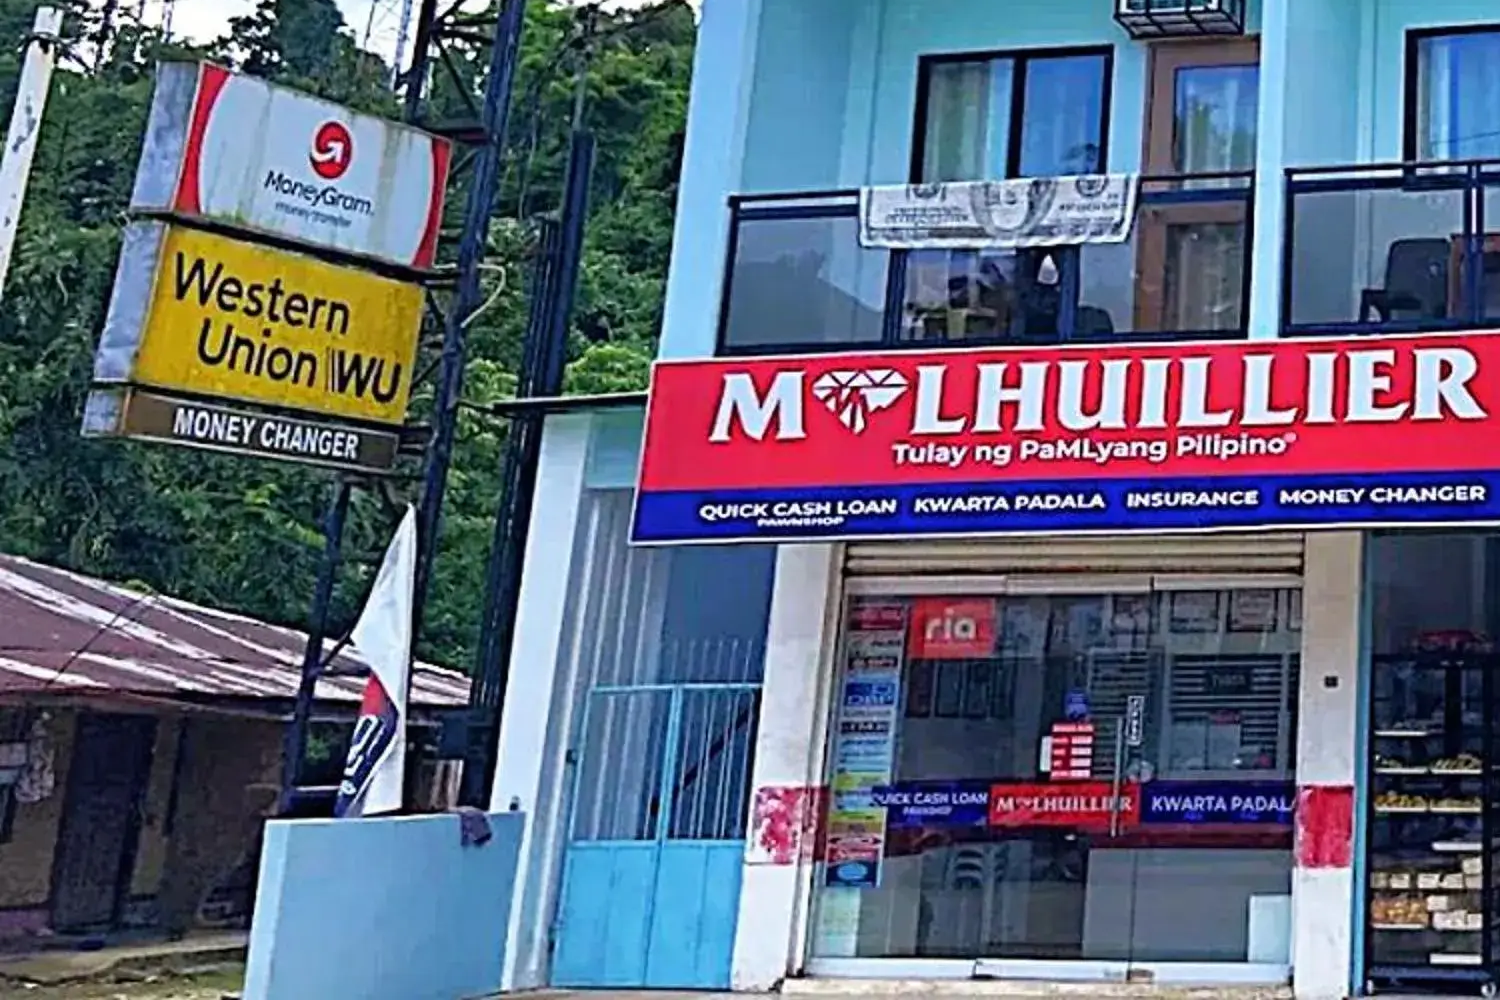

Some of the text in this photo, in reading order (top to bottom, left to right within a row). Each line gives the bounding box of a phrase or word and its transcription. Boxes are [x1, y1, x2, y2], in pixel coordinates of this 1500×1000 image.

[264, 170, 372, 215] MoneyGram
[175, 252, 349, 335] Western
[199, 318, 400, 403] Union WU
[173, 407, 359, 460] MONEY CHANGER
[893, 434, 1287, 465] Tulay ng PaMLyang Pilipino
[914, 493, 1106, 513] KWARTA PADALA
[1127, 490, 1259, 507] INSURANCE
[1280, 485, 1486, 505] MONEY CHANGER
[700, 499, 897, 520] QUICK CASH LOAN
[757, 515, 845, 527] PAWNSHOP
[925, 607, 977, 640] ria
[913, 792, 949, 806] CASH
[952, 791, 988, 806] LOAN
[1152, 795, 1227, 811] KWARTA
